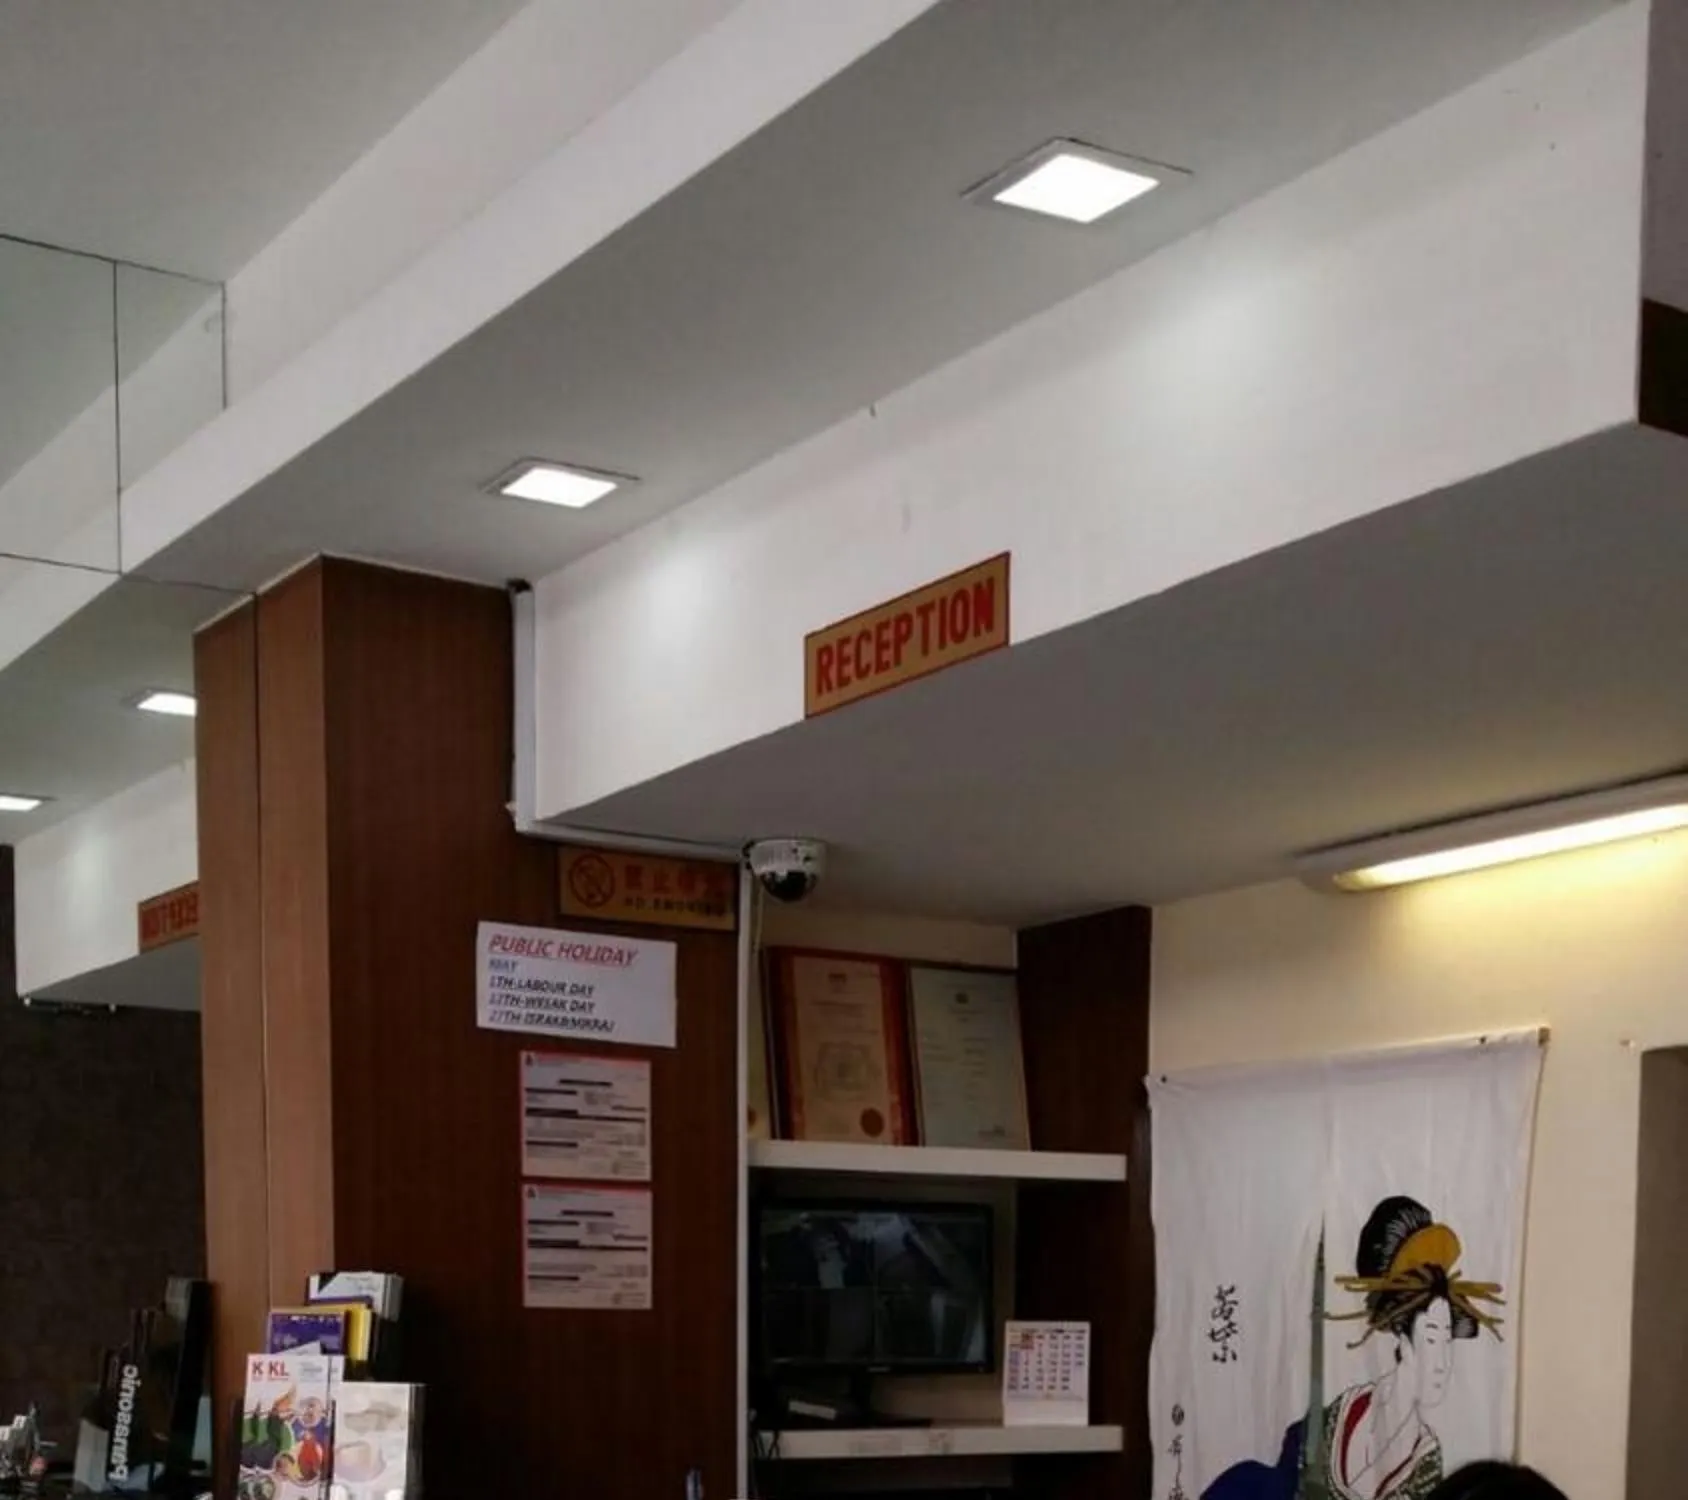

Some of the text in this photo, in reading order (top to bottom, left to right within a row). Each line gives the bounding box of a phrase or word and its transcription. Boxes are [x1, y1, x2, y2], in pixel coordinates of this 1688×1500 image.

[816, 577, 995, 695] RECEPTION
[488, 934, 638, 968] PUBLIC HOLIDAY
[569, 983, 595, 997] DAY
[569, 1000, 596, 1014] DAY
[268, 1360, 290, 1377] KL
